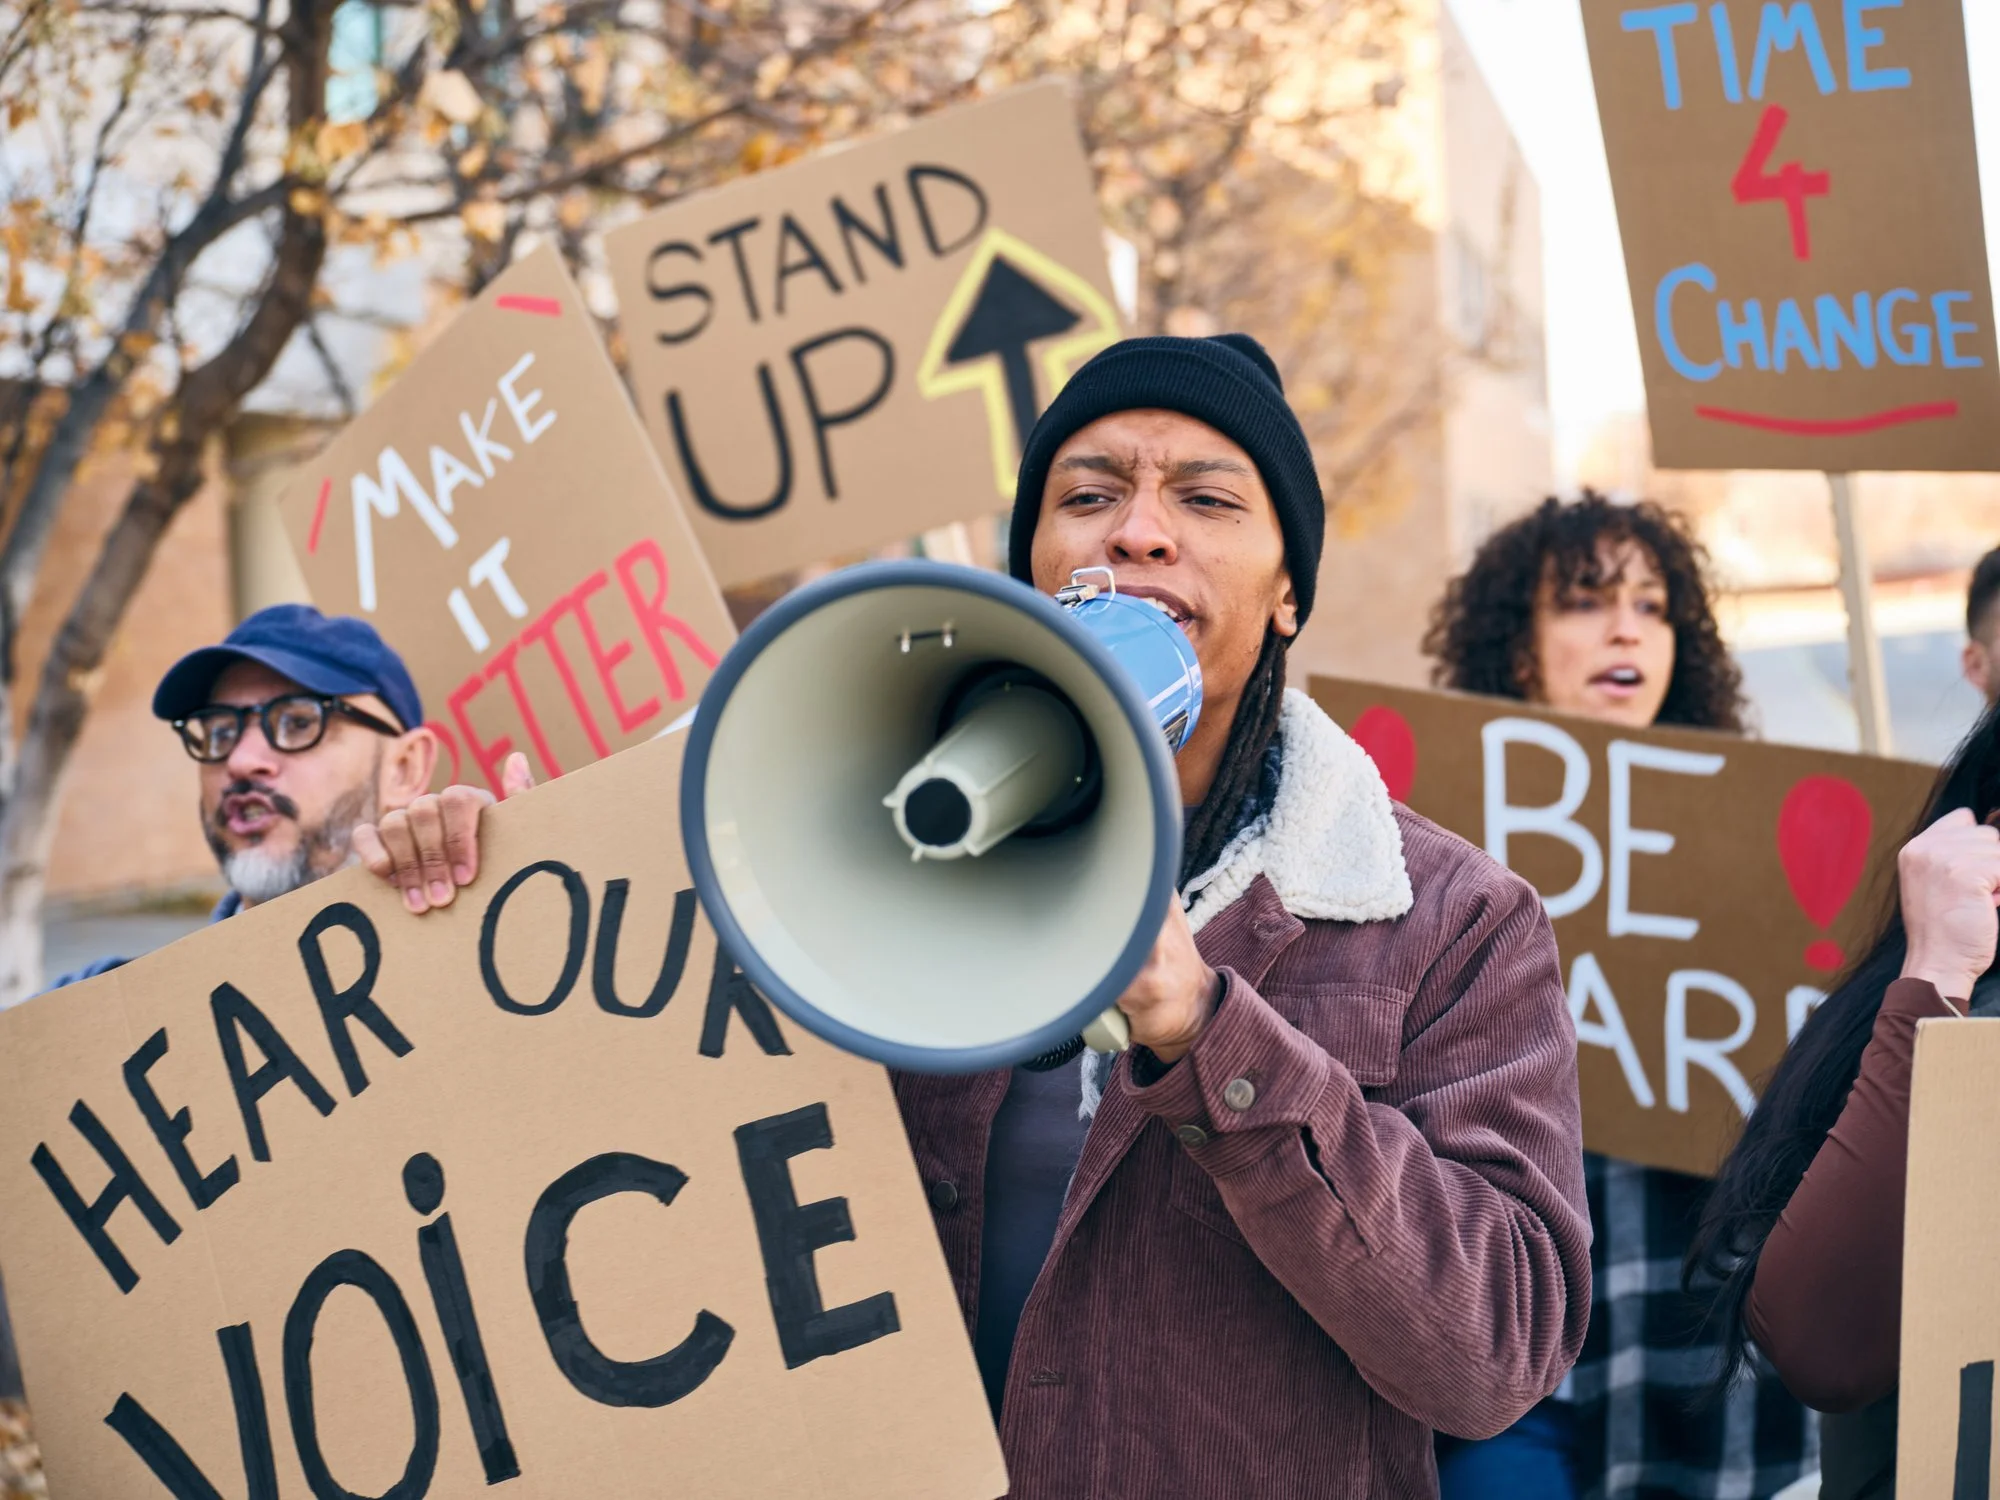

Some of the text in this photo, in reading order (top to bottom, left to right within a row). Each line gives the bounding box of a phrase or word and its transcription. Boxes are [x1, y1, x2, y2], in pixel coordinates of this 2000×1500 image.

[1620, 0, 1911, 109] TIME
[645, 164, 988, 346] STAND
[1731, 103, 1830, 261] 4
[1655, 262, 1984, 381] CHANGE
[350, 352, 558, 612] MAKE
[663, 326, 895, 523] UP
[447, 536, 528, 653] IT
[1481, 716, 1725, 940] BE
[30, 901, 414, 1294] HEAR
